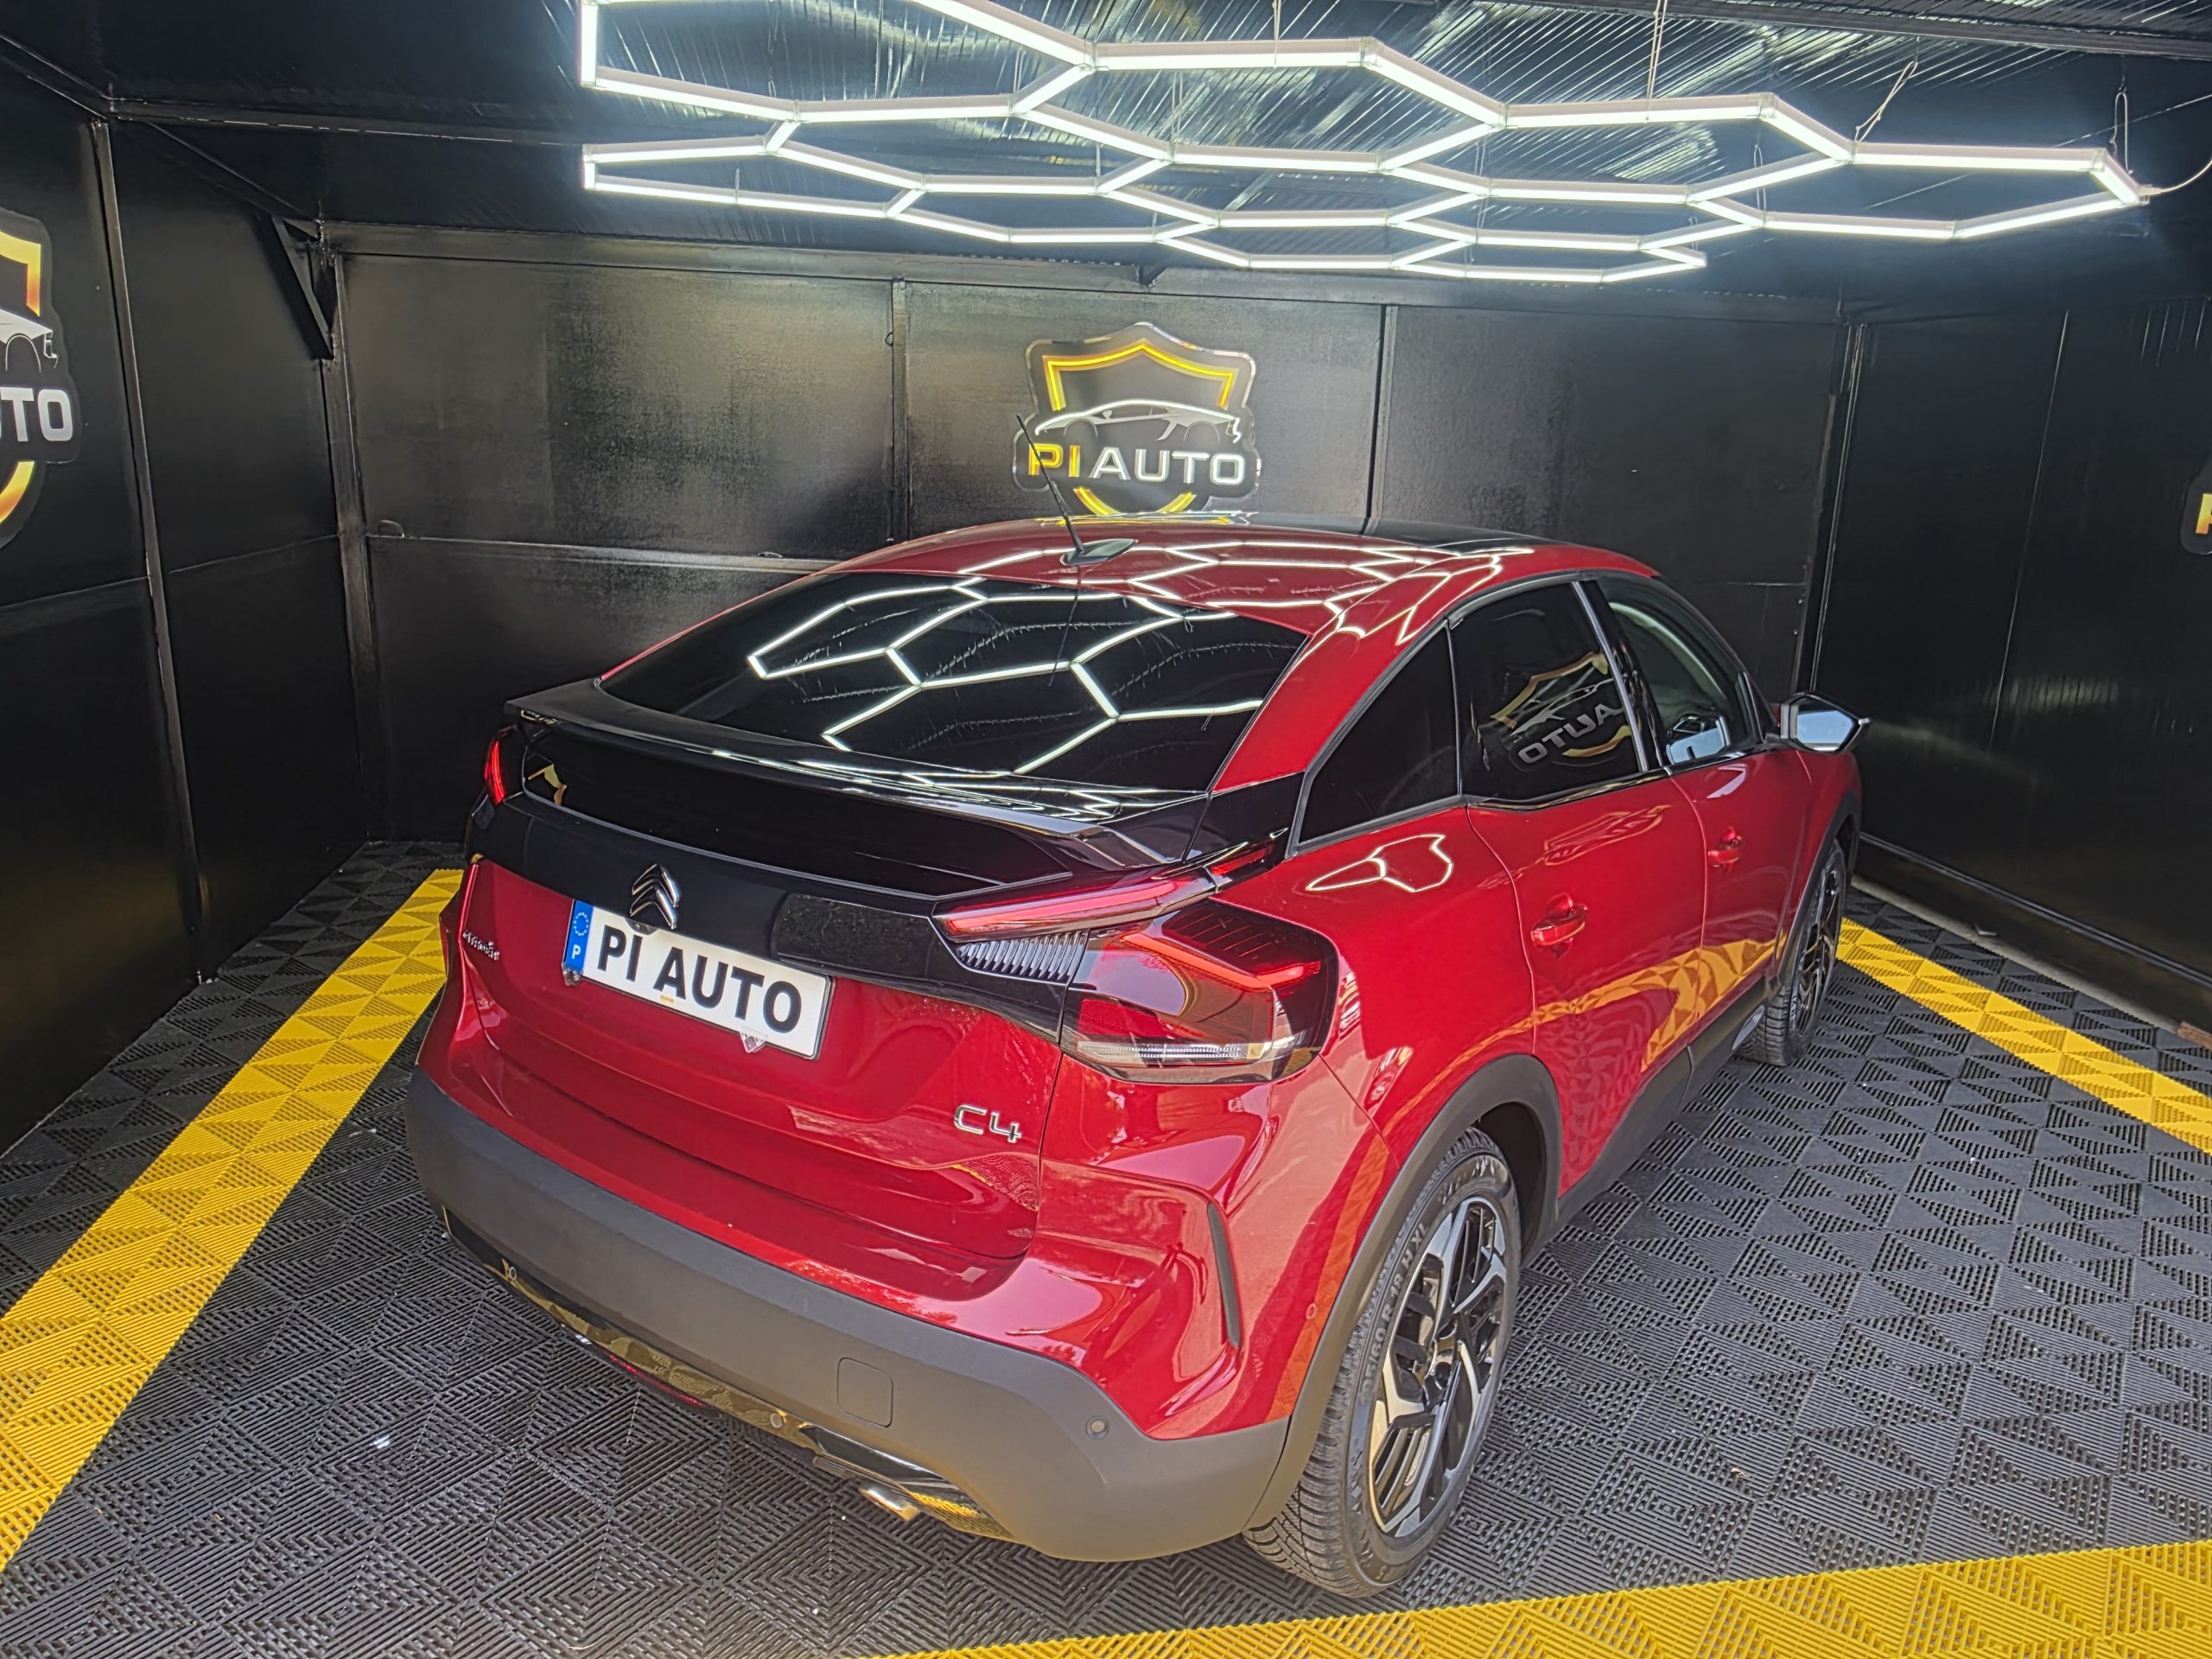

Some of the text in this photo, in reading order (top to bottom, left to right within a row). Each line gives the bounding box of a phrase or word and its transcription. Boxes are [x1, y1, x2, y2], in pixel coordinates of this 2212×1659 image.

[0, 386, 73, 442] TO
[1028, 442, 1245, 486] PI AUTO
[571, 944, 582, 960] P
[597, 925, 802, 1034] PI AUTO
[954, 1103, 1022, 1144] C4
